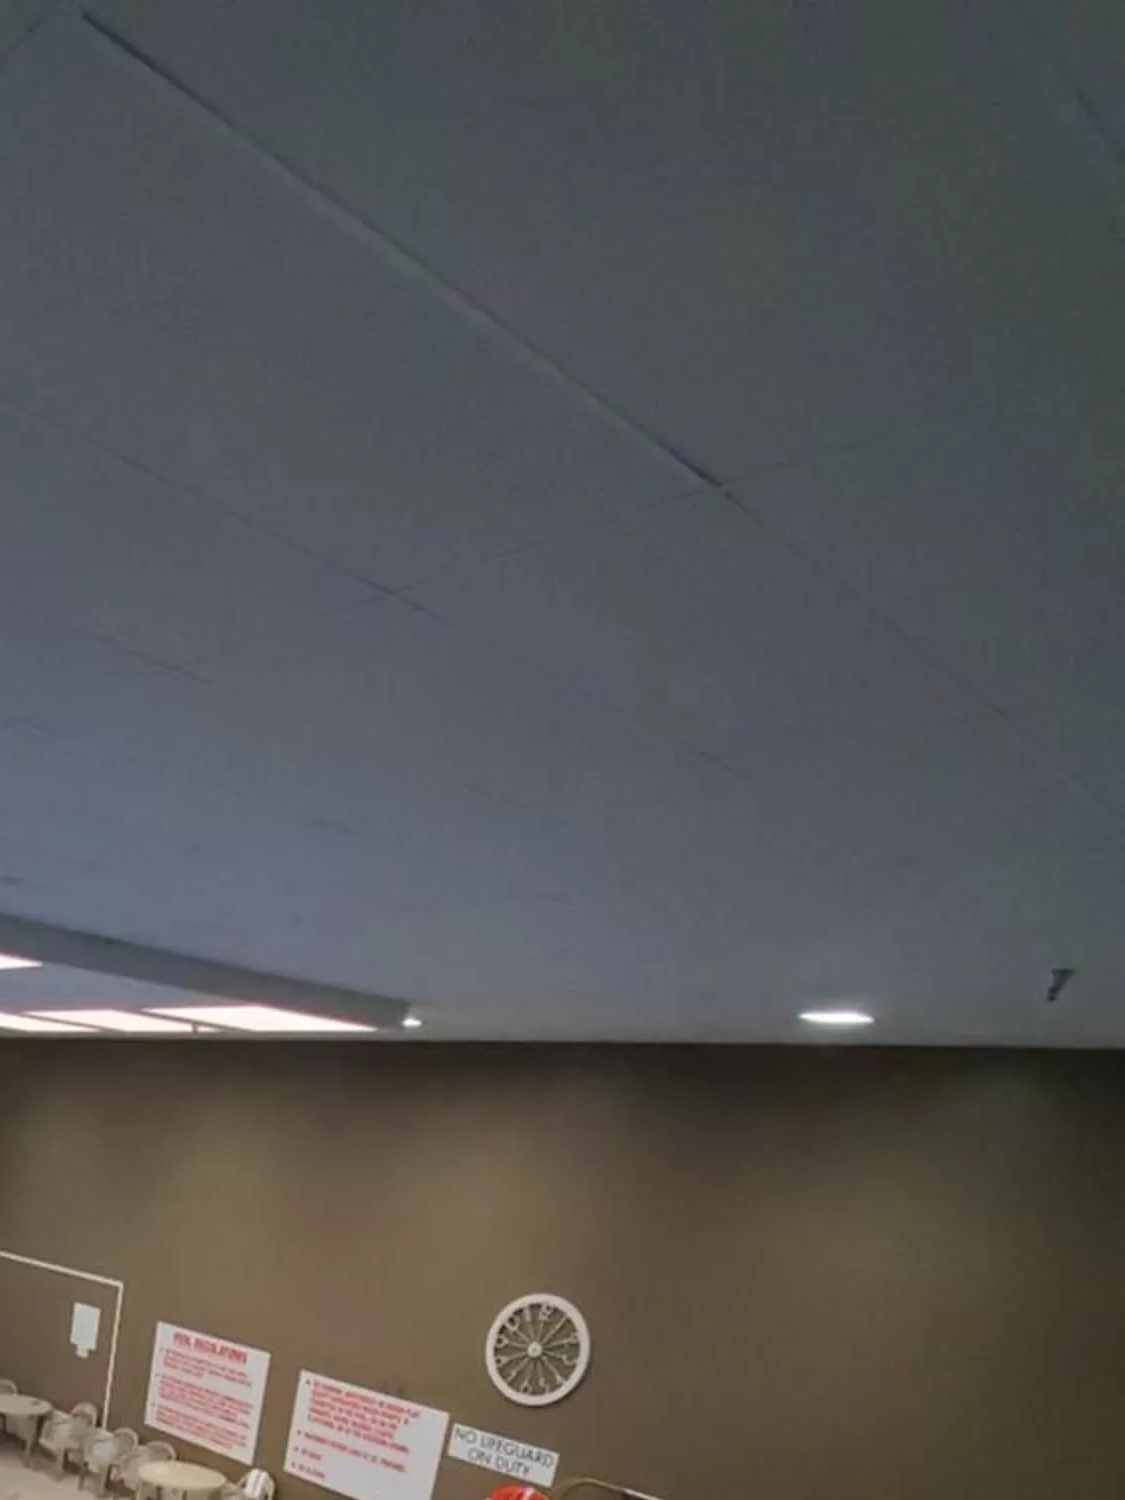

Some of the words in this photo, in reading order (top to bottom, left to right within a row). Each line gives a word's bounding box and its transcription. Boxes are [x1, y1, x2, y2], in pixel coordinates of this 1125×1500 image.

[455, 1427, 477, 1444] NO
[480, 1435, 555, 1469] LIFEGUARD
[467, 1446, 493, 1465] ON
[494, 1455, 533, 1476] DUTY
